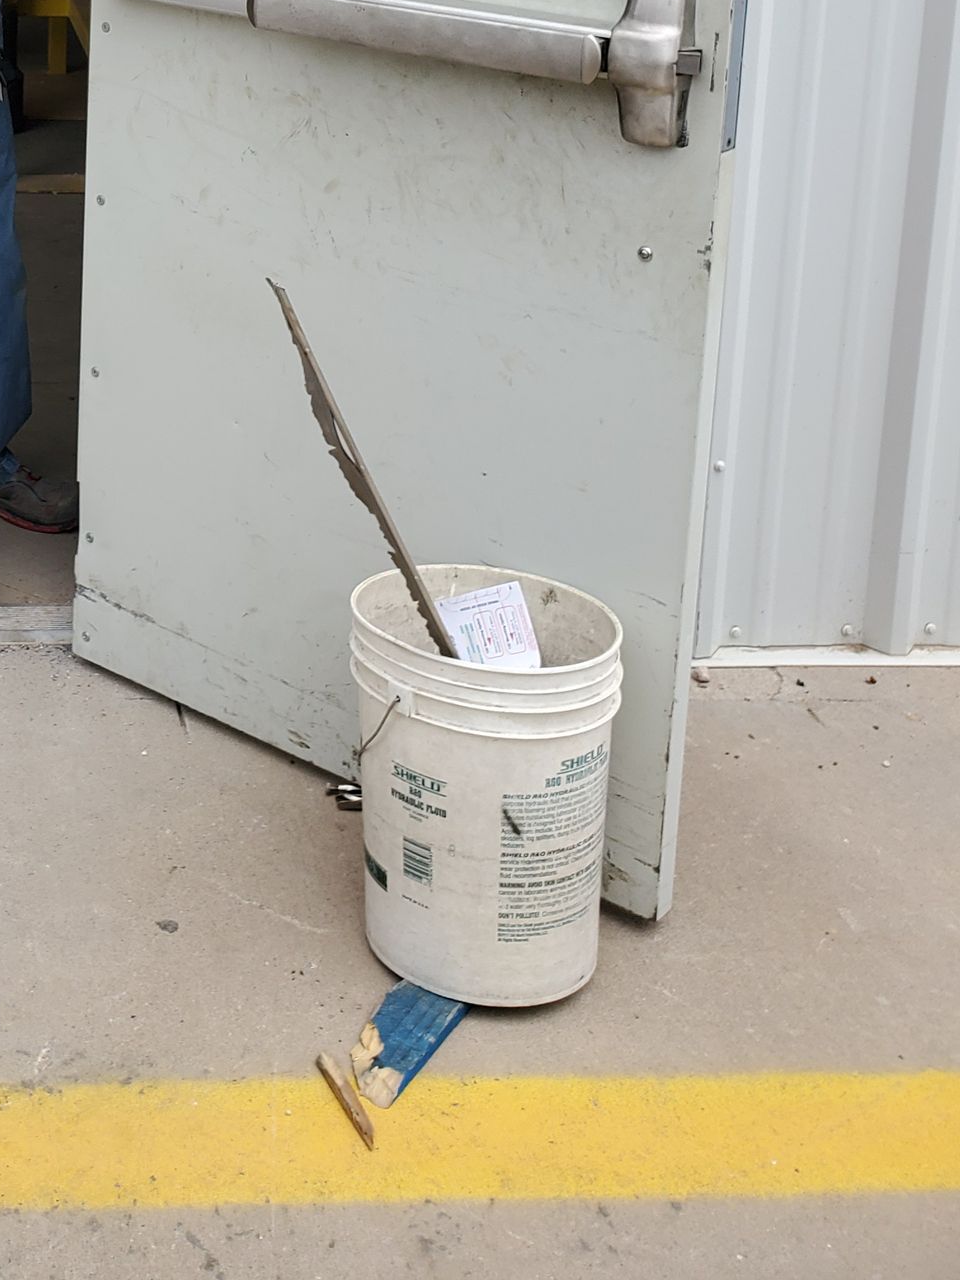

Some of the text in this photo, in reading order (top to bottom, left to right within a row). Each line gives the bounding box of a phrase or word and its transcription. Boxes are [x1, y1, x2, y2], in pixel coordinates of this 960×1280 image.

[560, 744, 604, 771] SHIELD
[393, 765, 441, 793] SHIELD
[391, 786, 424, 811] HYDRAULIC
[426, 803, 447, 819] FLUID
